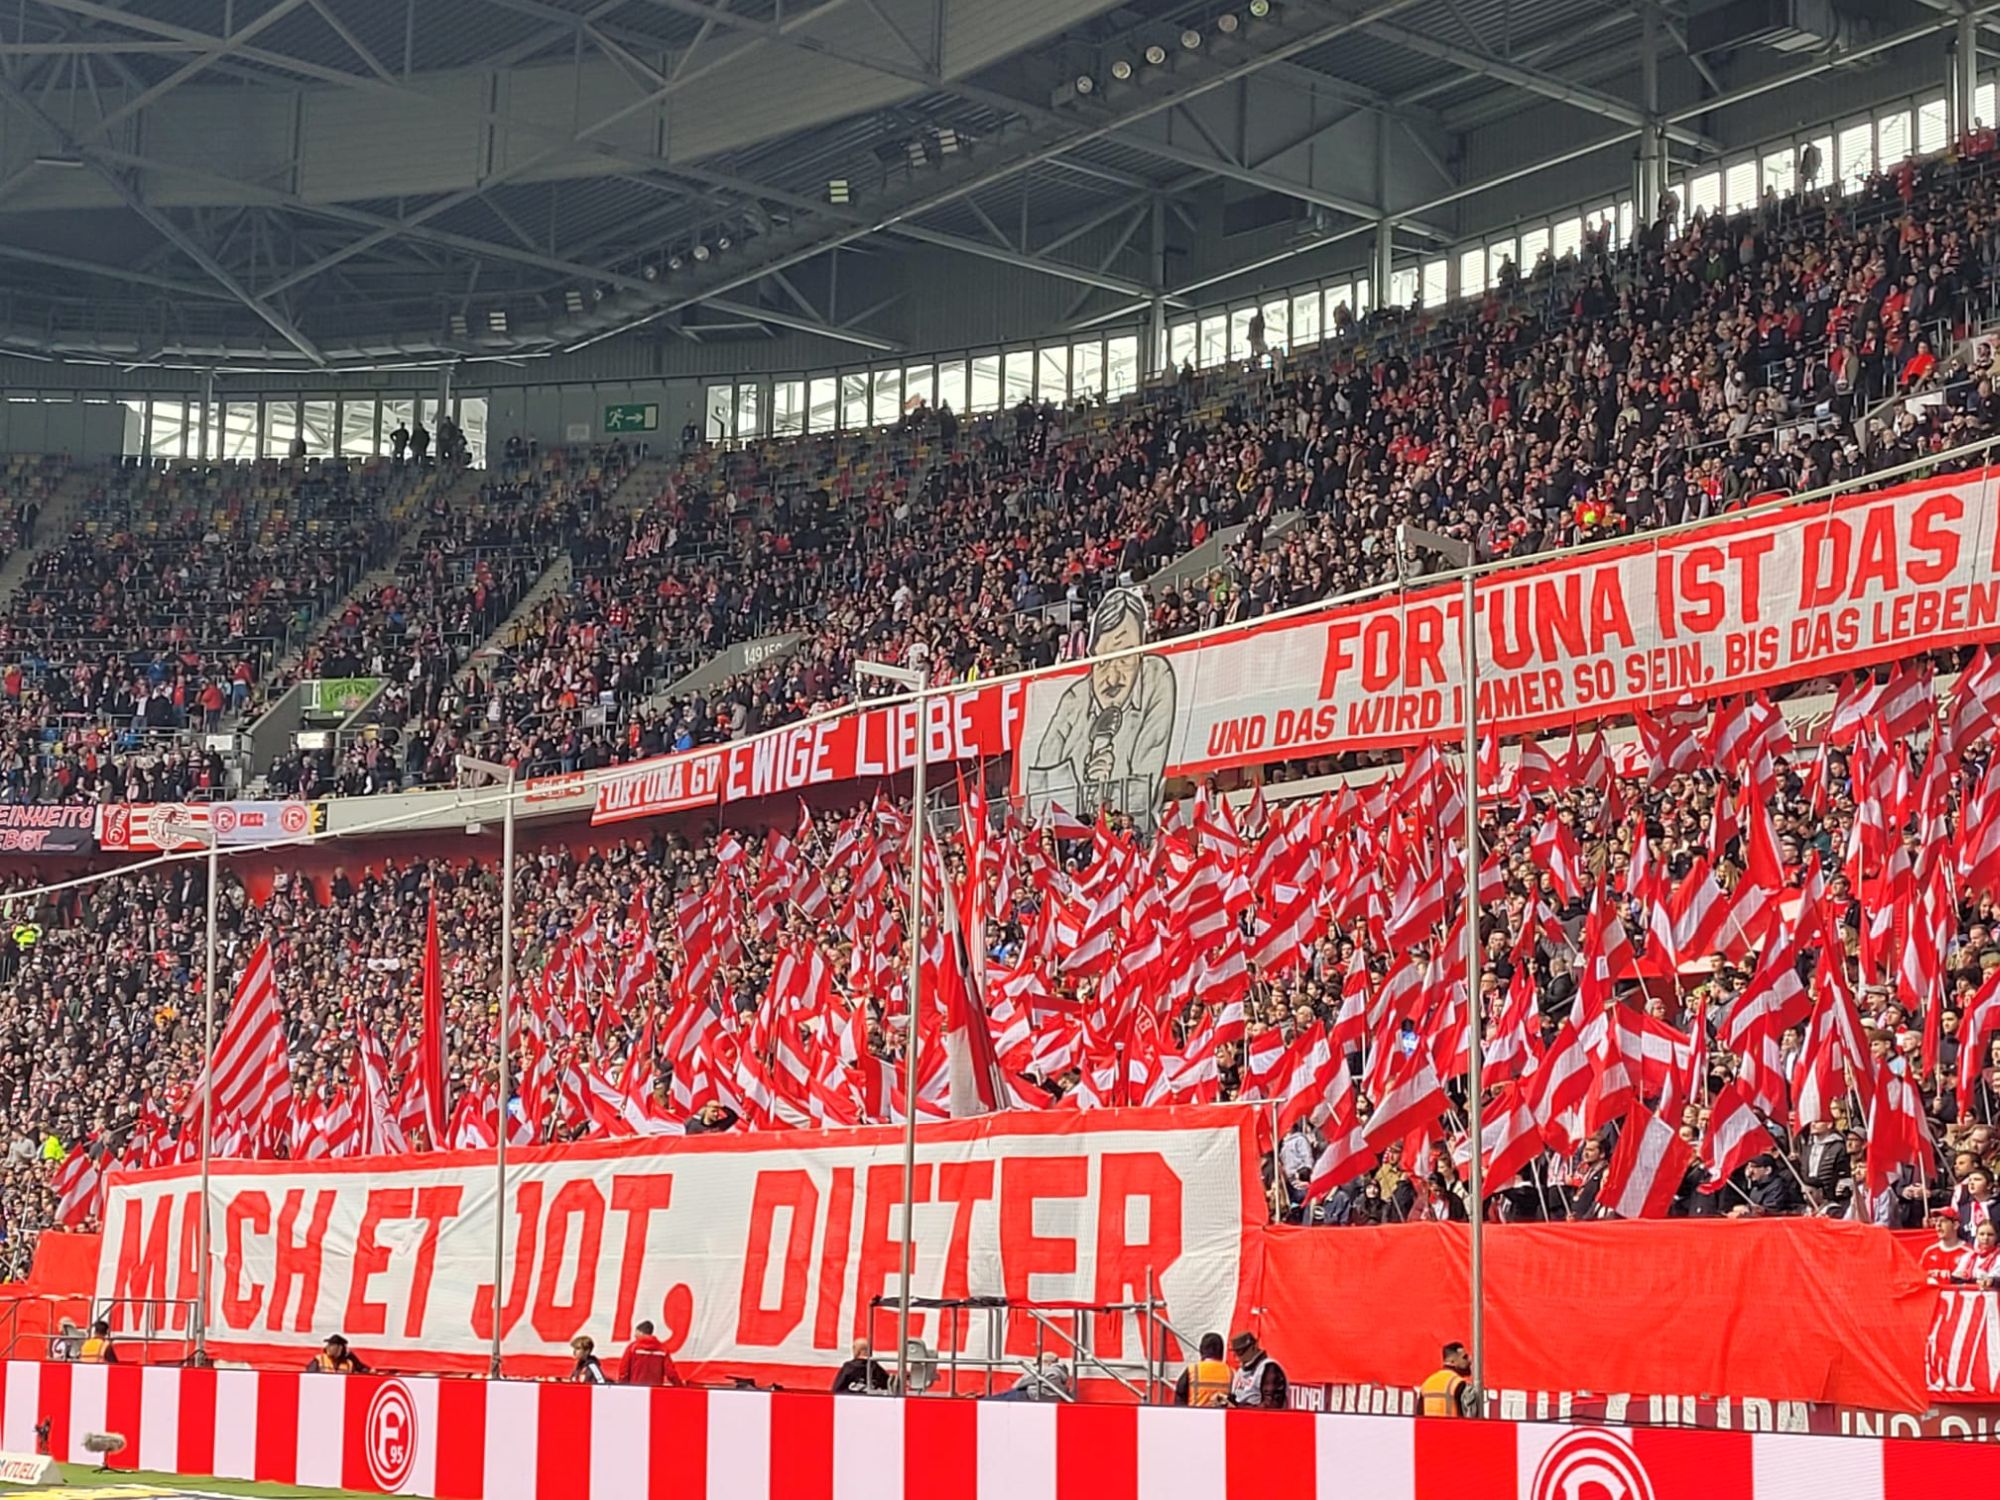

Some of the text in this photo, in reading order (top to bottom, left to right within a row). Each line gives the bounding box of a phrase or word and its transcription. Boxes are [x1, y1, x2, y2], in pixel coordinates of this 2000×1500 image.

[744, 646, 762, 665] 149
[1319, 568, 1635, 700] FORTUNA
[1657, 533, 1774, 640] IST
[1799, 494, 1963, 610] DAS
[726, 719, 840, 801] EWIGE
[855, 690, 979, 775] LIEBE
[1207, 715, 1266, 756] UND
[1274, 702, 1337, 745] DAS
[1347, 688, 1442, 736] WIRD
[1453, 667, 1564, 723] IMMER
[1573, 657, 1615, 703] SO
[1626, 641, 1714, 695] SEIN,
[1726, 626, 1779, 677] BIS
[1790, 607, 1860, 662] DAS
[110, 1152, 1184, 1361] MACH ET JOT, DIETER
